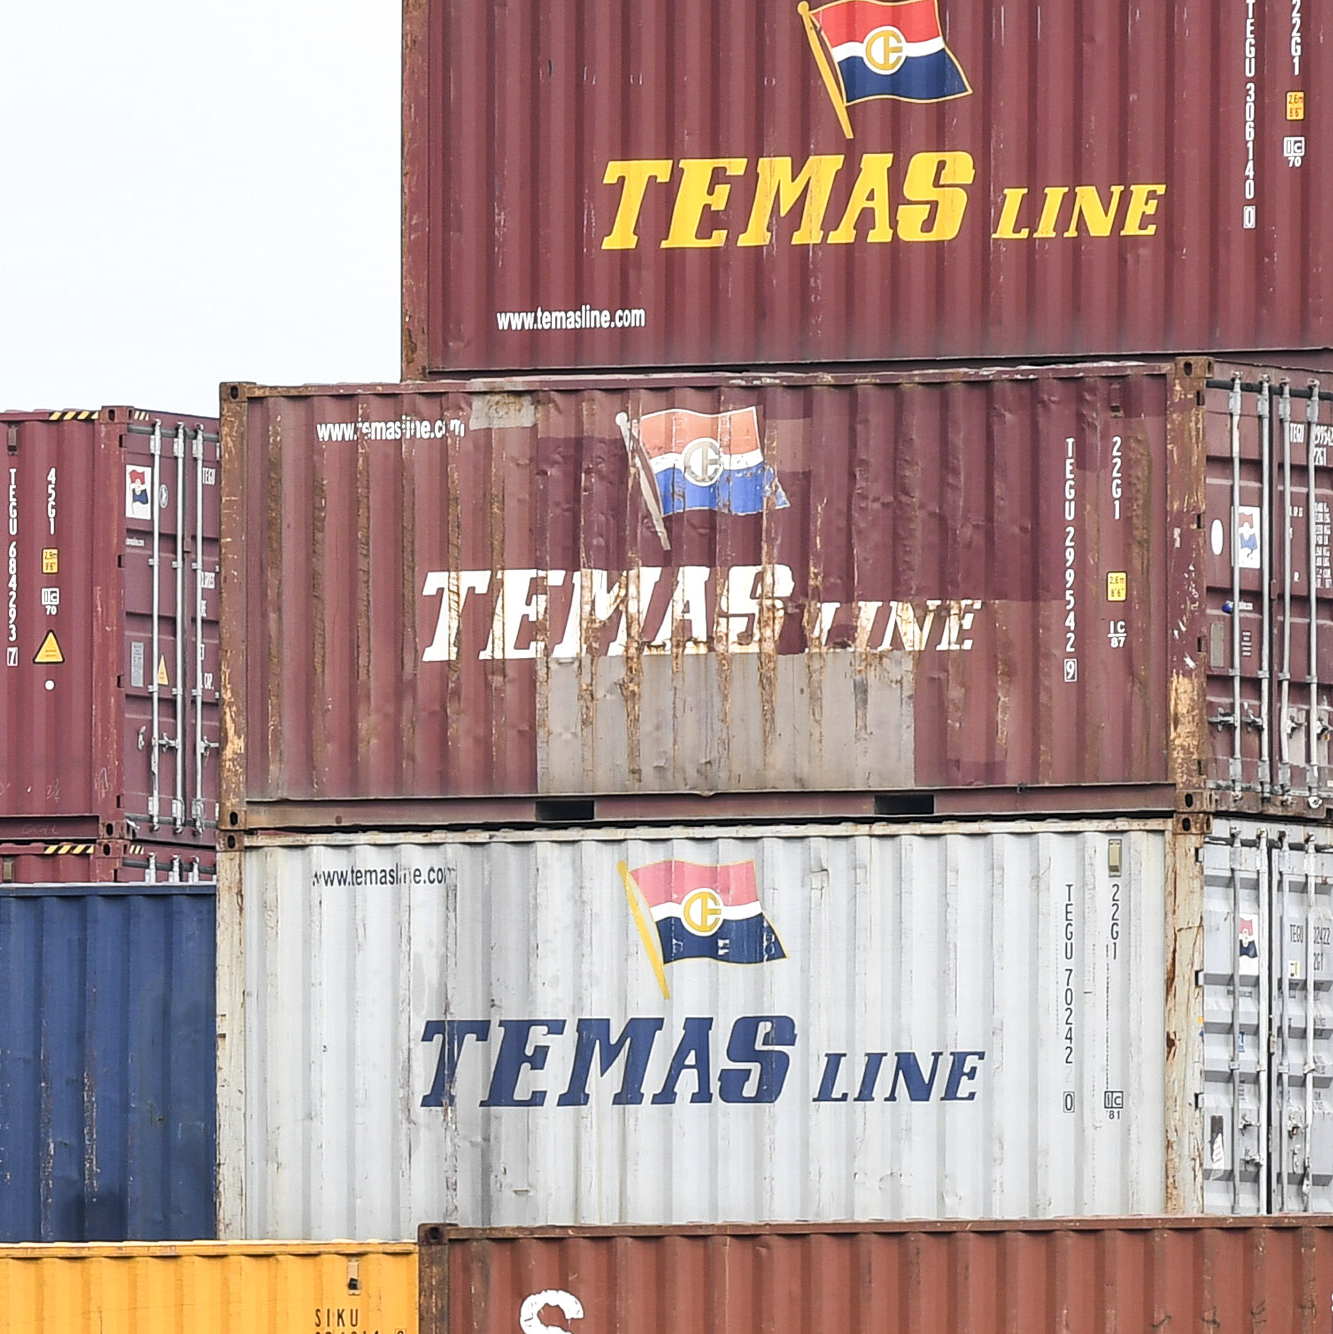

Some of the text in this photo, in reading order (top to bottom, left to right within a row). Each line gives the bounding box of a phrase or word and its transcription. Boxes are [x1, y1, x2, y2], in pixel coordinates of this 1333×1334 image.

[1245, 0, 1256, 77] TEGU
[1291, 0, 1302, 76] 22G1
[1244, 83, 1255, 202] 306140
[1288, 157, 1302, 167] 70
[601, 151, 1167, 250] TEMAS LINE
[496, 305, 647, 333] www.temasline.com
[1290, 423, 1305, 443] TEGU
[8, 468, 18, 535] TEGU
[46, 468, 56, 534] 45G1
[1111, 436, 1123, 520] 22G1
[8, 541, 17, 642] 684293
[1065, 438, 1076, 681] TEGU 299542 9
[45, 606, 57, 615] 70
[421, 564, 985, 663] TEMAS LINE
[1110, 637, 1126, 648] 87
[1065, 884, 1074, 960] TEGU
[1110, 884, 1121, 960] 22G1
[1289, 924, 1304, 943] TEGU
[1064, 968, 1074, 1064] 70242
[421, 1015, 986, 1108] TEMAS LINE
[1109, 1110, 1121, 1120] 81
[315, 1308, 358, 1328] SIKU
